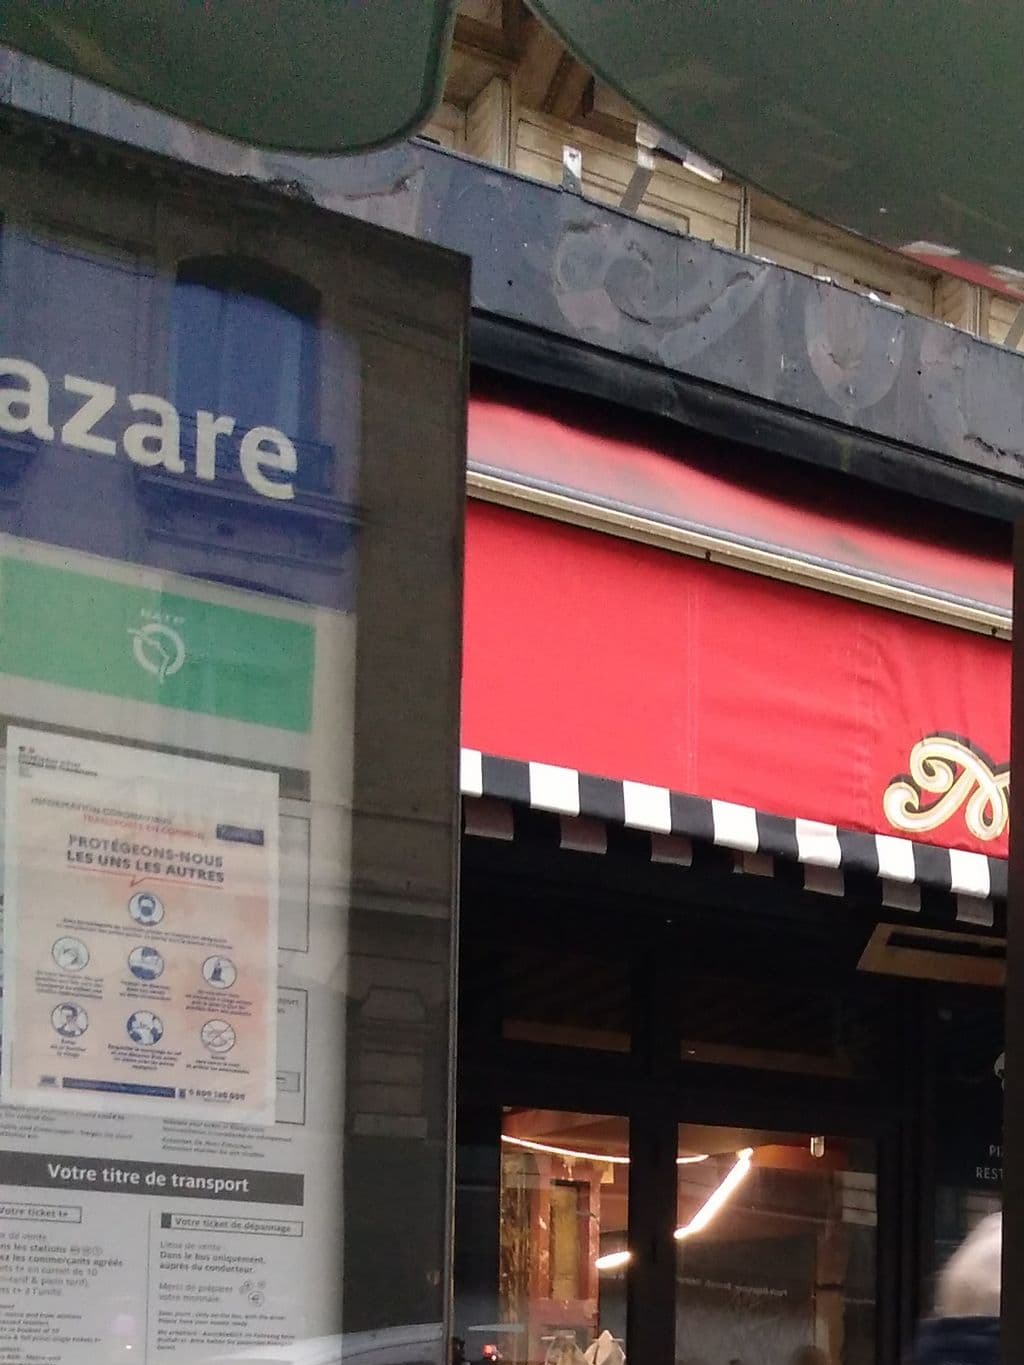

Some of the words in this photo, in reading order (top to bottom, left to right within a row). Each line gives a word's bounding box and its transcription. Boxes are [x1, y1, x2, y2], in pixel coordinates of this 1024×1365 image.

[69, 833, 223, 868] PROTÉGEONS-NOUS
[67, 850, 94, 864] LES
[99, 856, 131, 869] UNS
[135, 861, 162, 874] LES
[166, 864, 224, 882] AUTRES
[48, 1163, 97, 1182] Votre
[102, 1167, 140, 1185] titre
[146, 1172, 166, 1187] de
[172, 1174, 249, 1193] transport
[28, 1207, 56, 1217] ticket
[175, 1217, 200, 1227] Votre
[203, 1218, 228, 1227] ticket
[244, 1222, 291, 1232] dépannage
[160, 1251, 181, 1259] Dans
[160, 1263, 188, 1271] auprès
